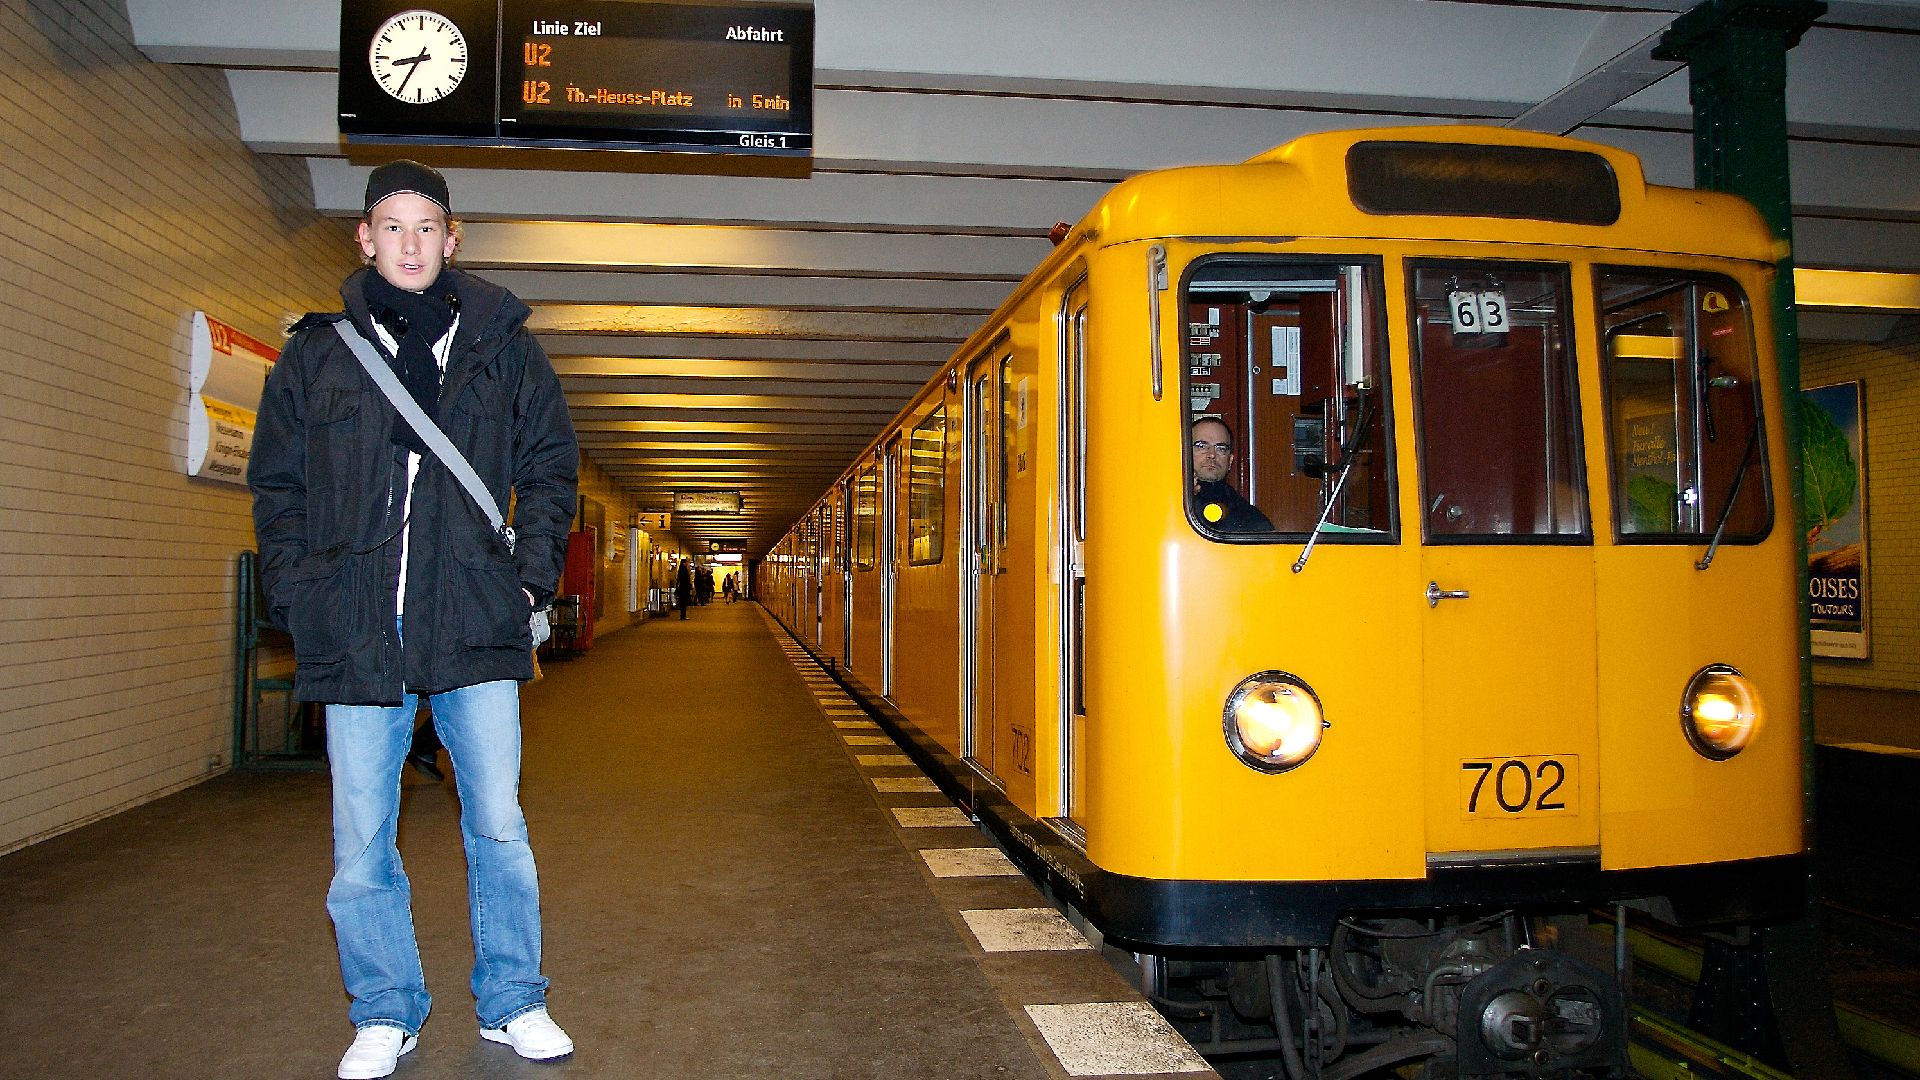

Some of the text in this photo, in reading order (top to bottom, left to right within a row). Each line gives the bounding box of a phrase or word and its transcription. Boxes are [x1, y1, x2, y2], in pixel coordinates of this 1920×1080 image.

[533, 20, 602, 36] Linie Ziel
[725, 25, 784, 42] Abfahrt
[524, 42, 552, 67] U2
[523, 80, 551, 105] U2
[565, 86, 693, 107] Th.-Heuss-Platz
[727, 93, 742, 109] in
[739, 133, 787, 149] Gleis 1
[1809, 577, 1858, 599] OISES
[1011, 727, 1030, 773] 702
[1461, 759, 1566, 813] 702
